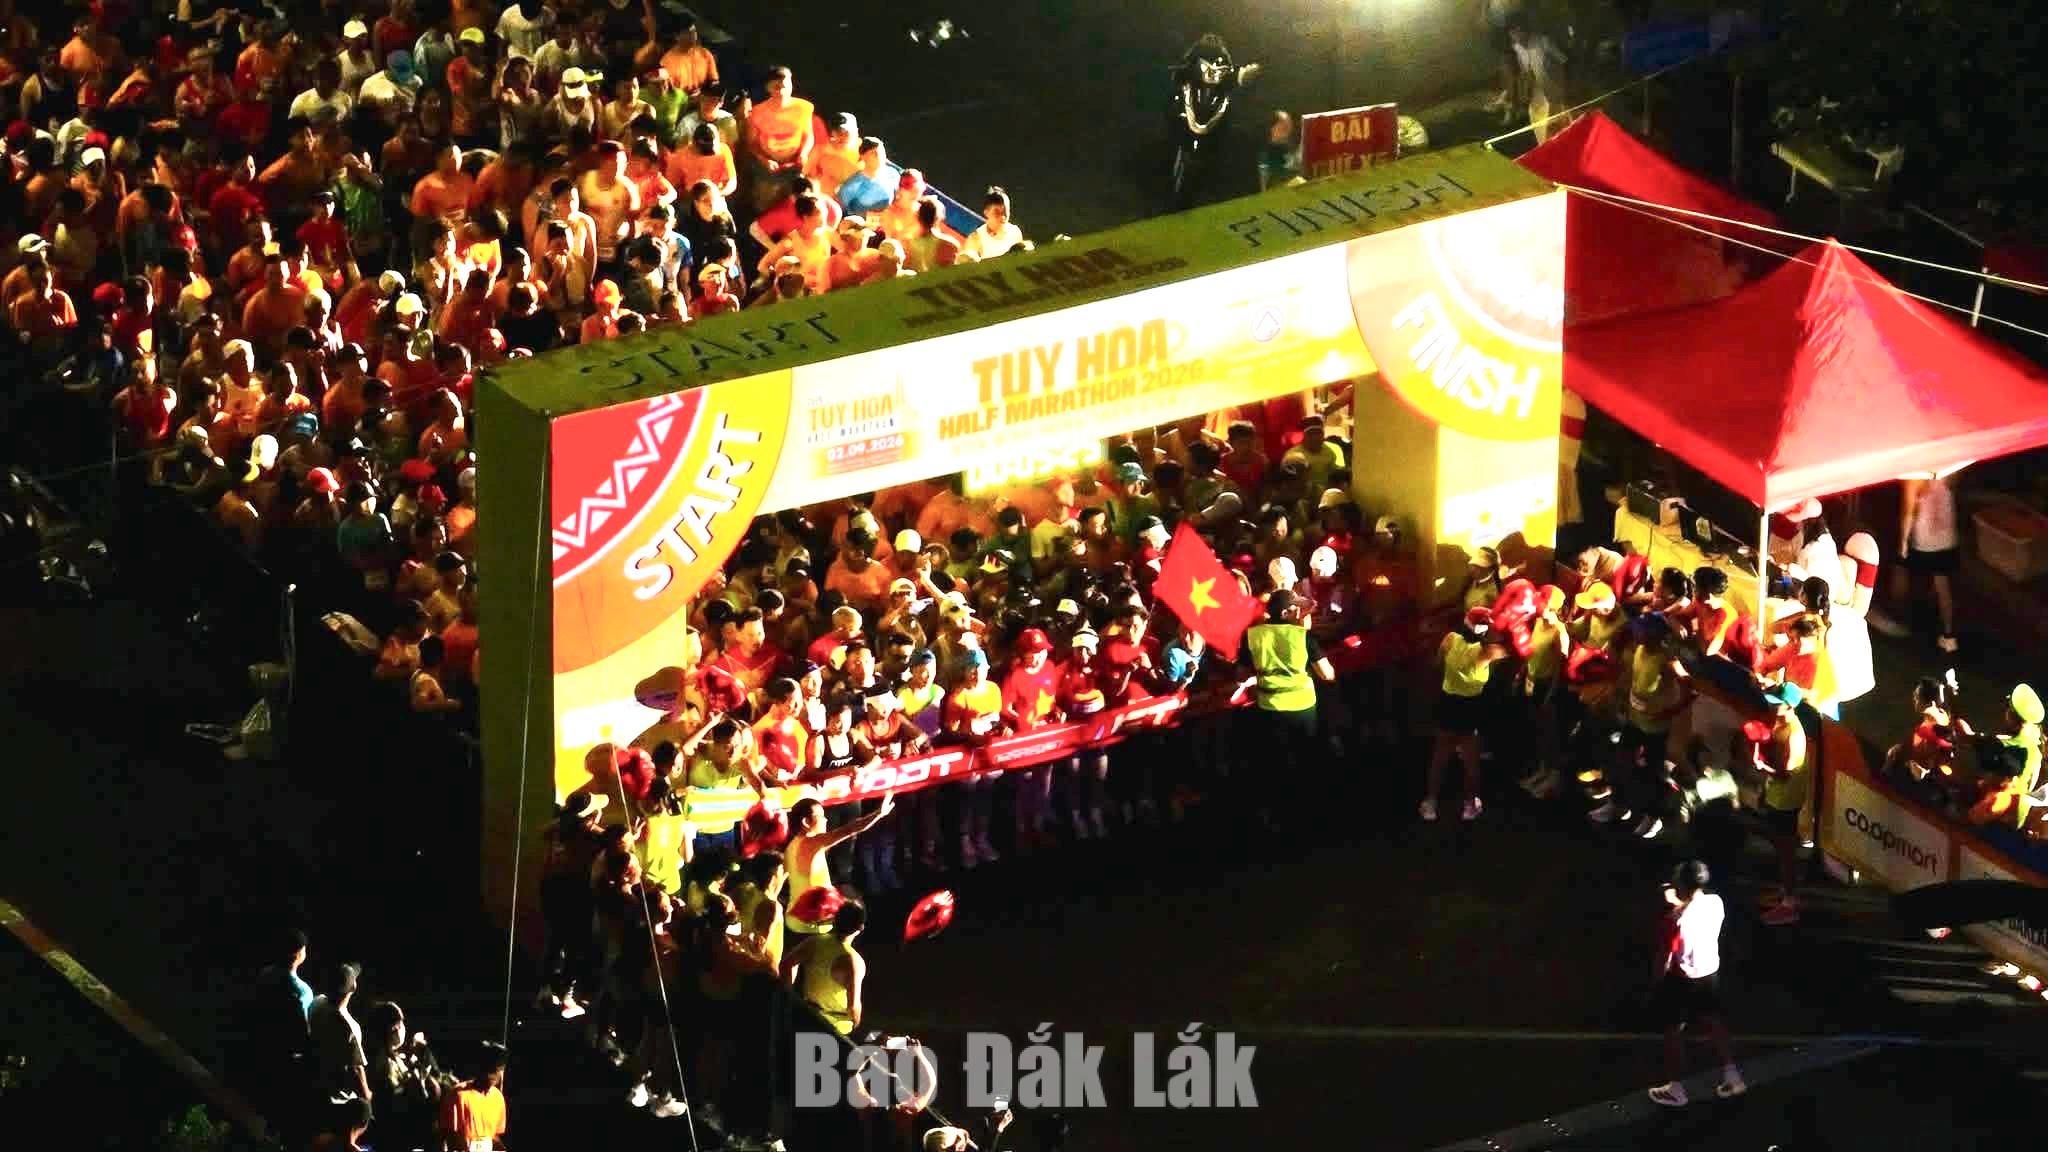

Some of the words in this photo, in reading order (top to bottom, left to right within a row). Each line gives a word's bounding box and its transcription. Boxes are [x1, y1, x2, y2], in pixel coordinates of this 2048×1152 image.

[1330, 113, 1371, 144] BÃI
[1228, 173, 1474, 249] FINISH
[972, 341, 1065, 404] TUY
[1075, 318, 1168, 382] HOA
[1391, 291, 1541, 418] FINISH
[808, 404, 847, 432] TUY
[853, 394, 894, 423] HOA
[939, 406, 999, 441] HALF
[1005, 375, 1138, 425] MARATHON
[1141, 362, 1206, 394] 2026
[624, 413, 763, 601] START
